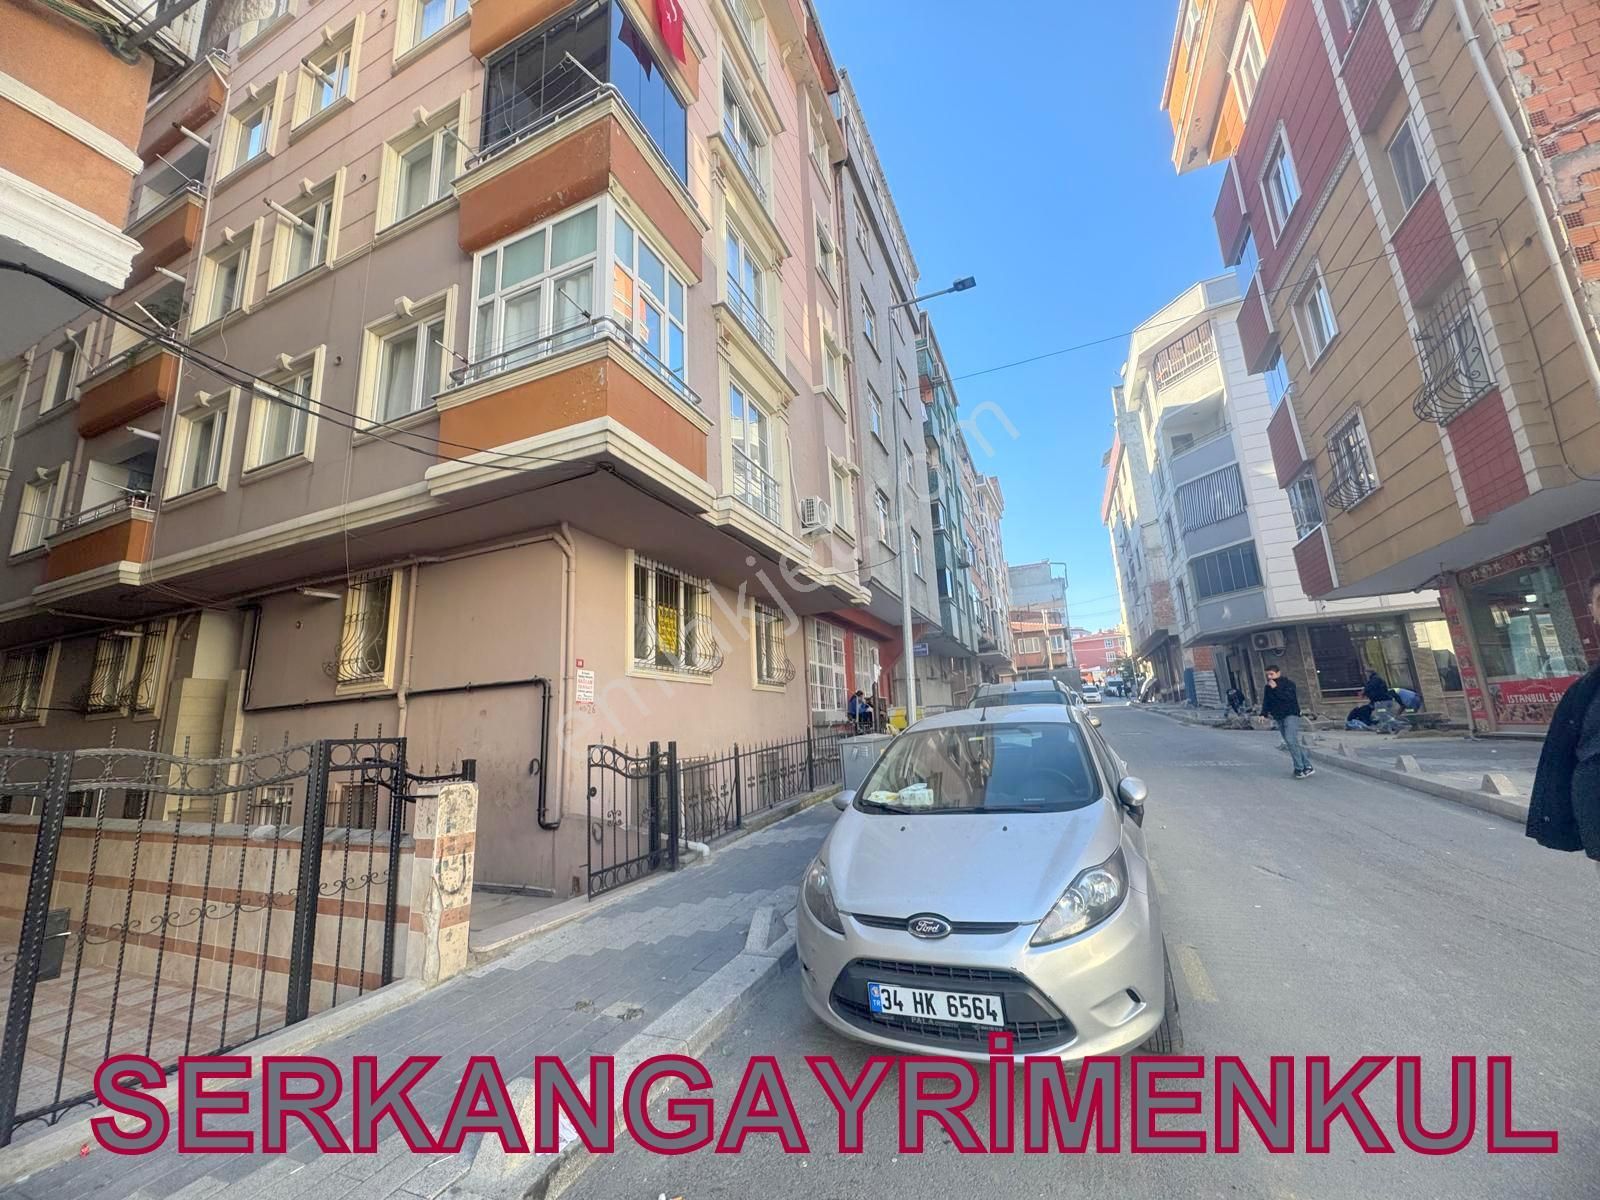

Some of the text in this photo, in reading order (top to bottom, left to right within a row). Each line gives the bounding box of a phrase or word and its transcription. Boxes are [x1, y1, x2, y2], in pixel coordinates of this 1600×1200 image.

[1507, 693, 1549, 703] İSTANBUL
[916, 921, 940, 932] Ford
[872, 999, 881, 1007] TR
[881, 988, 998, 1022] 34 HK 6564
